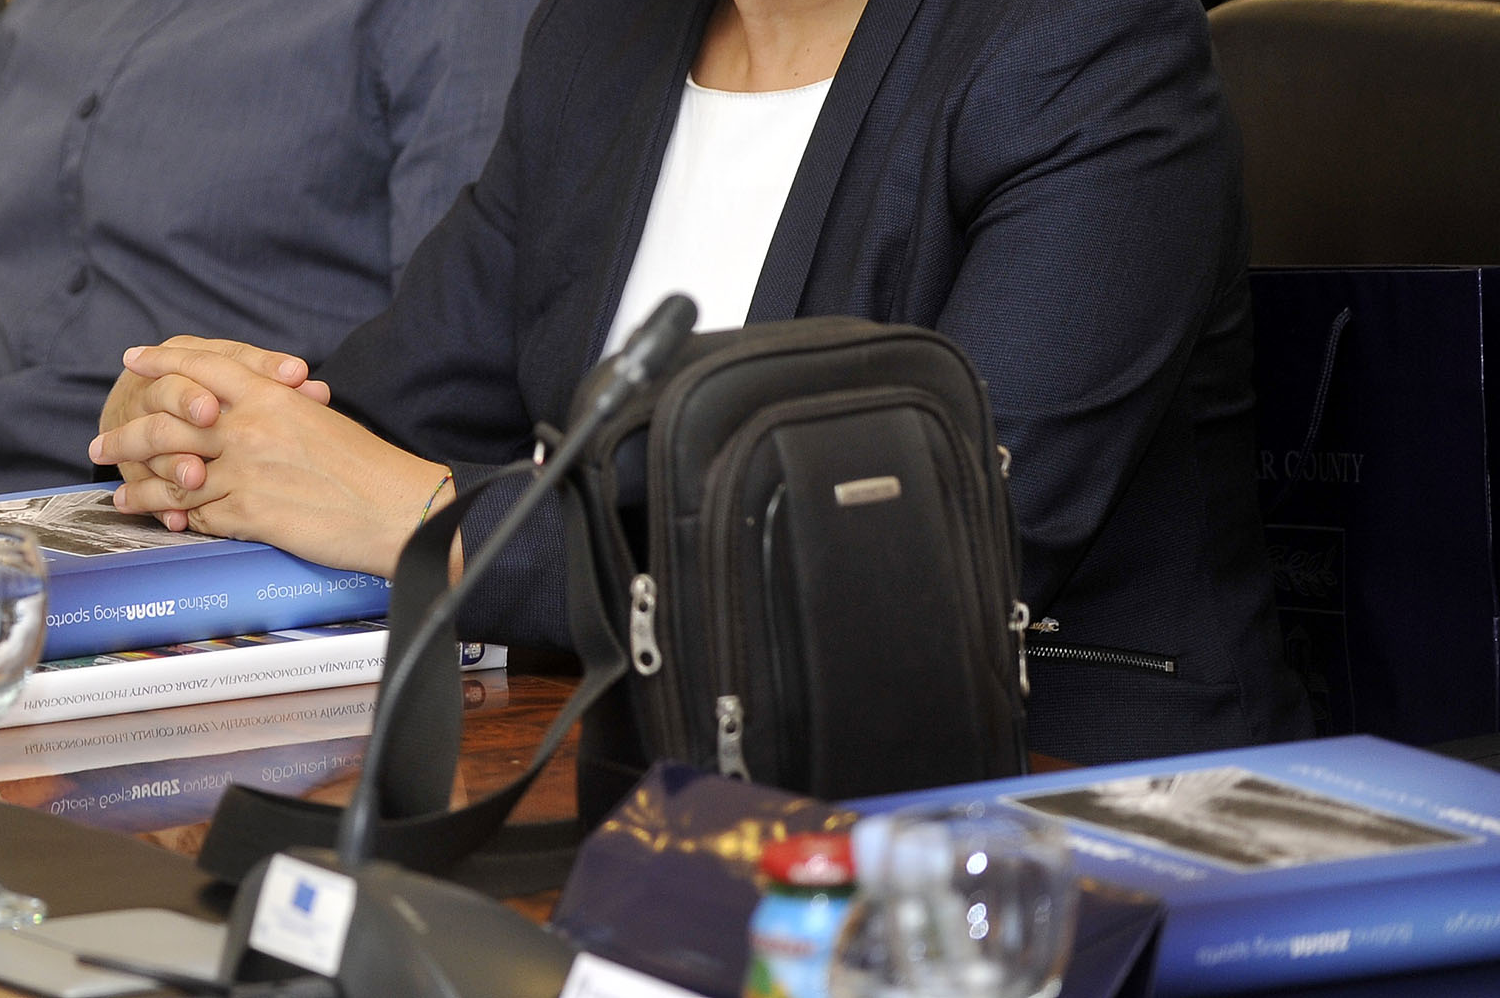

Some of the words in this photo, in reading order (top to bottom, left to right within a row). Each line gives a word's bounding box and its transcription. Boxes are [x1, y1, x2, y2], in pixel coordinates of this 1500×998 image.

[256, 581, 324, 602] heritage
[327, 576, 368, 595] sport
[94, 600, 175, 623] ZADARskog
[178, 593, 228, 611] Baština
[46, 607, 90, 628] sporta
[220, 665, 318, 686] FOTOMONOGRAFIJA
[318, 658, 365, 674] ŽUPANIJA
[129, 683, 174, 700] COUNTY
[176, 679, 209, 693] ZADAR
[23, 687, 128, 711] PHOTOMONOGRAPH
